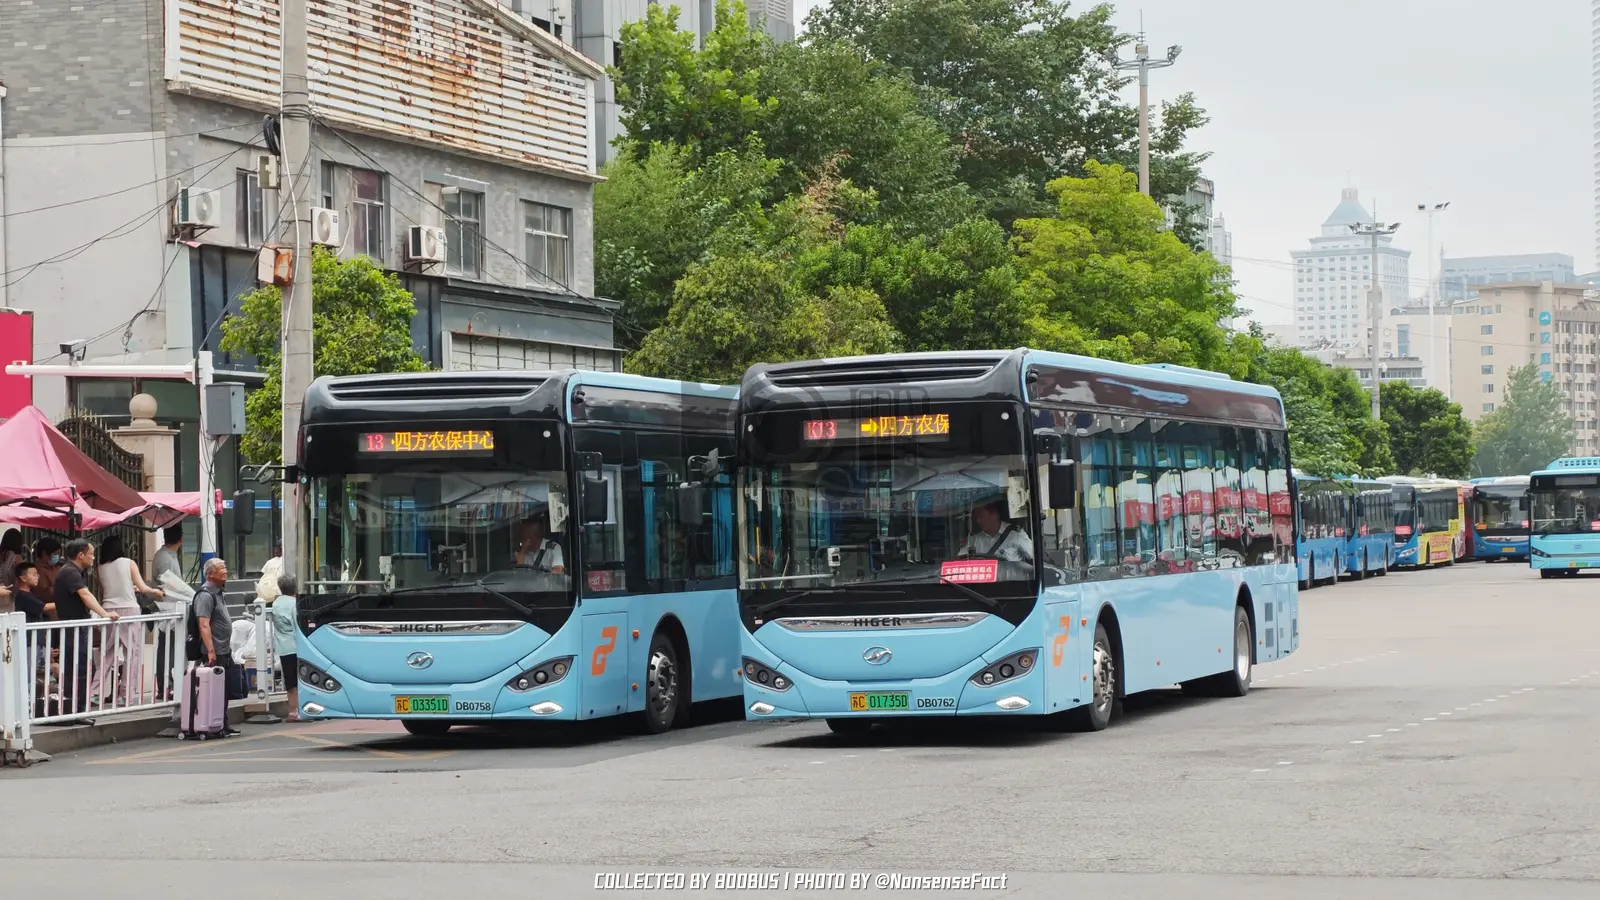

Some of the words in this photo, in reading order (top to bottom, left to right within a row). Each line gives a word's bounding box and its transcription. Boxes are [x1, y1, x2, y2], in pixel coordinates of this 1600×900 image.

[806, 421, 836, 439] K13
[880, 413, 949, 438] 四方农保
[366, 433, 385, 451] 13
[394, 430, 494, 451] 四方农保中心
[399, 623, 444, 633] HIGER
[853, 617, 901, 627] HIGER
[455, 701, 491, 711] DB0758
[916, 698, 955, 708] DB0762
